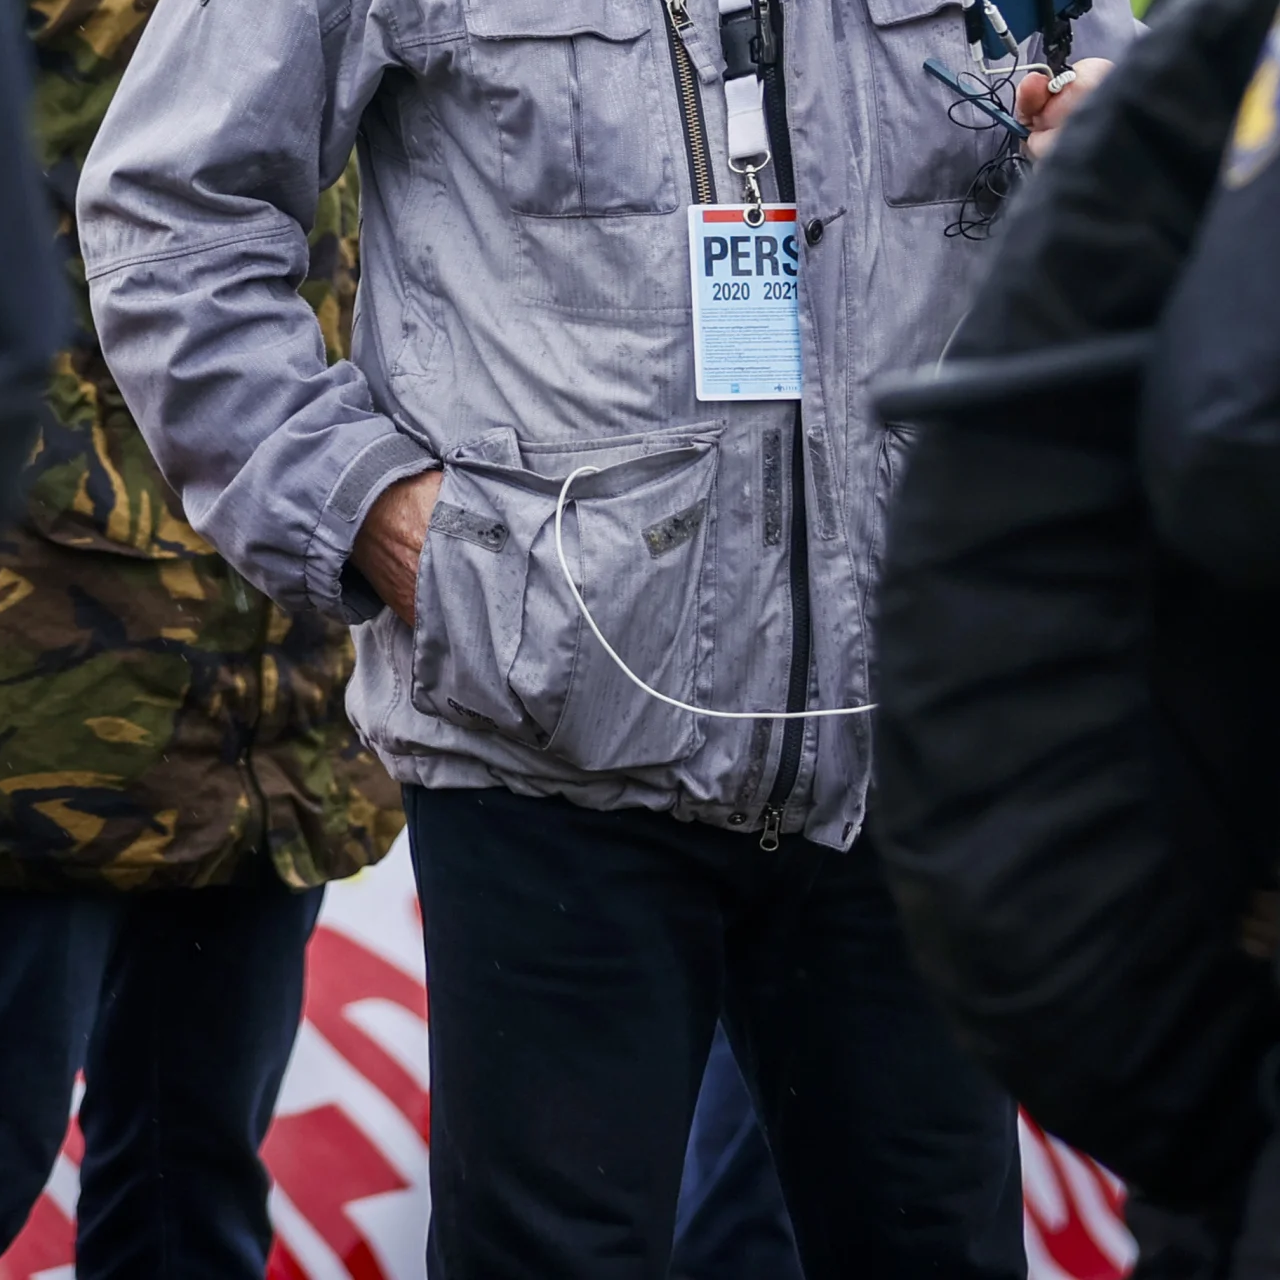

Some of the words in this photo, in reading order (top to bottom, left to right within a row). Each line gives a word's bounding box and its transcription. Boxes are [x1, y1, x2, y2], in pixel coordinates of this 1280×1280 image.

[703, 235, 799, 277] PERS
[712, 282, 750, 301] 2020
[763, 281, 798, 300] 2021
